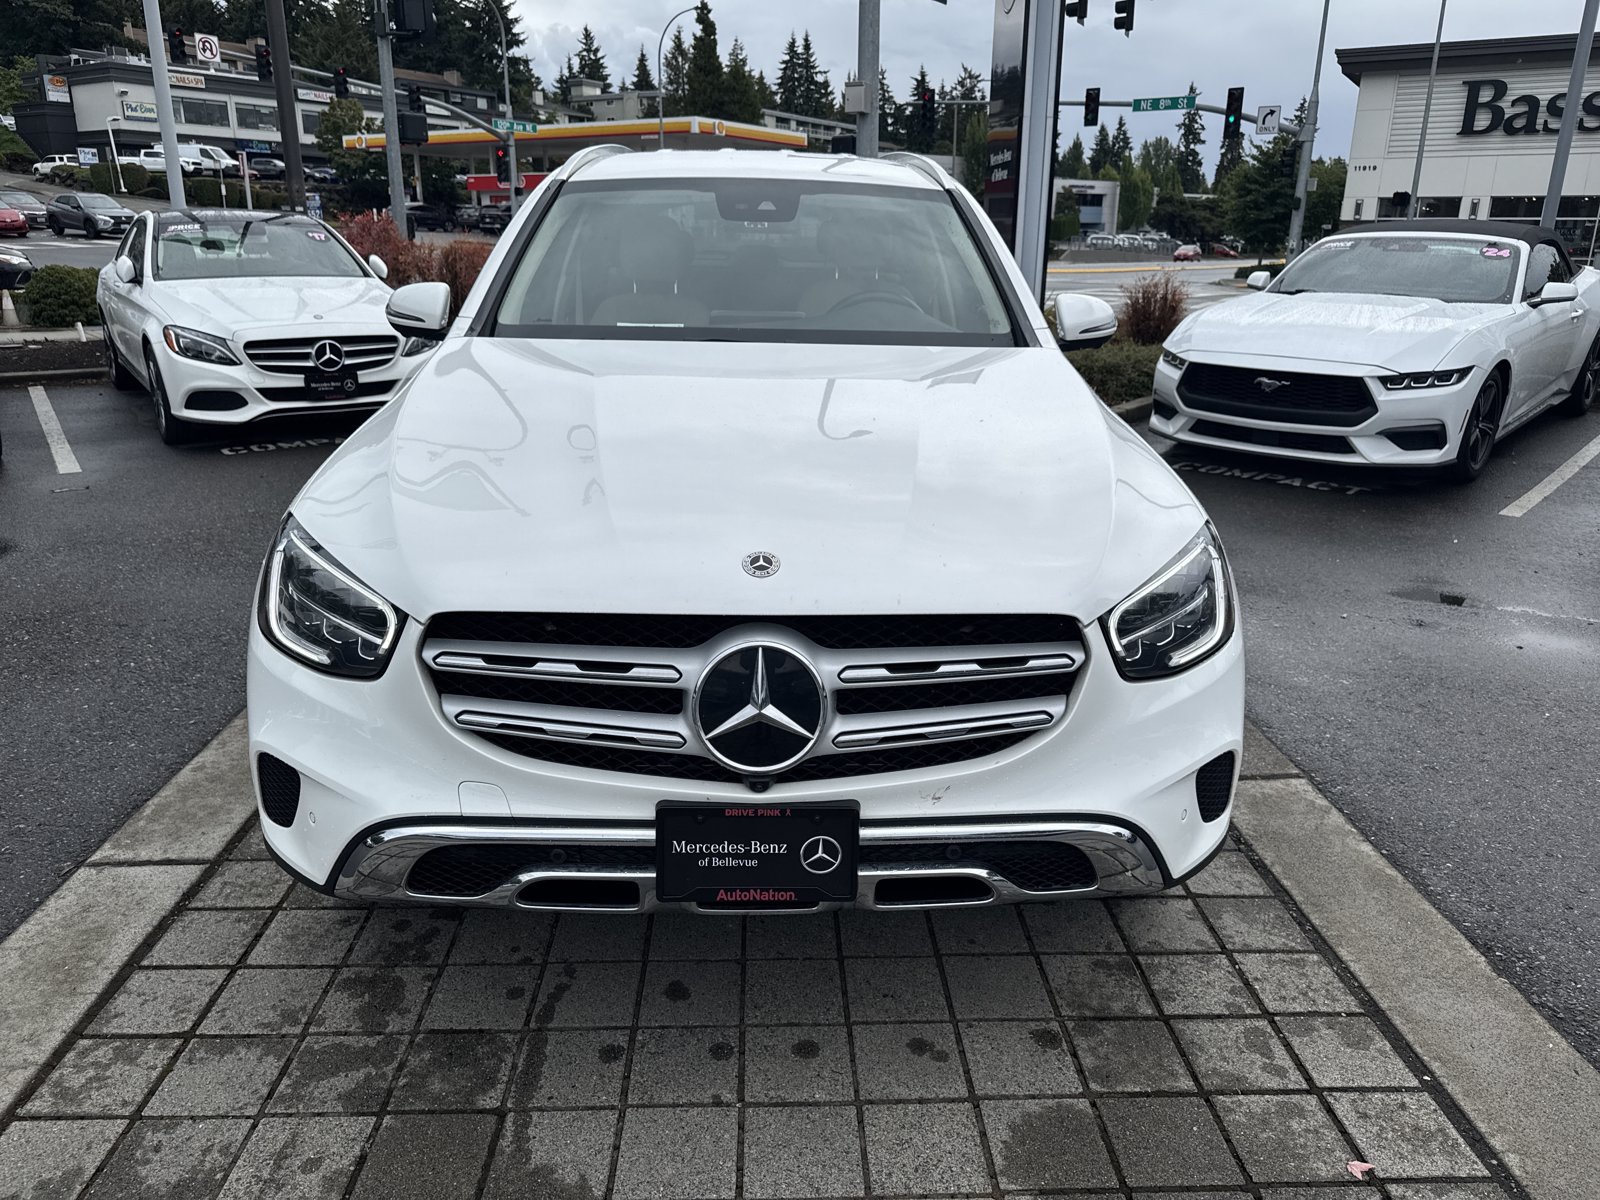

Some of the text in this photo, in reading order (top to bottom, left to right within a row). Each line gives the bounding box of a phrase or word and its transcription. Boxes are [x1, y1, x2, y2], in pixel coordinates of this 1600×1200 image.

[193, 77, 204, 86] SPA
[1140, 97, 1188, 110] NE 8th St
[1171, 461, 1372, 495] COMPACT
[725, 808, 781, 817] DRIVE PINK
[671, 840, 787, 854] Mercedes-Benz
[698, 857, 758, 867] of Bellevue
